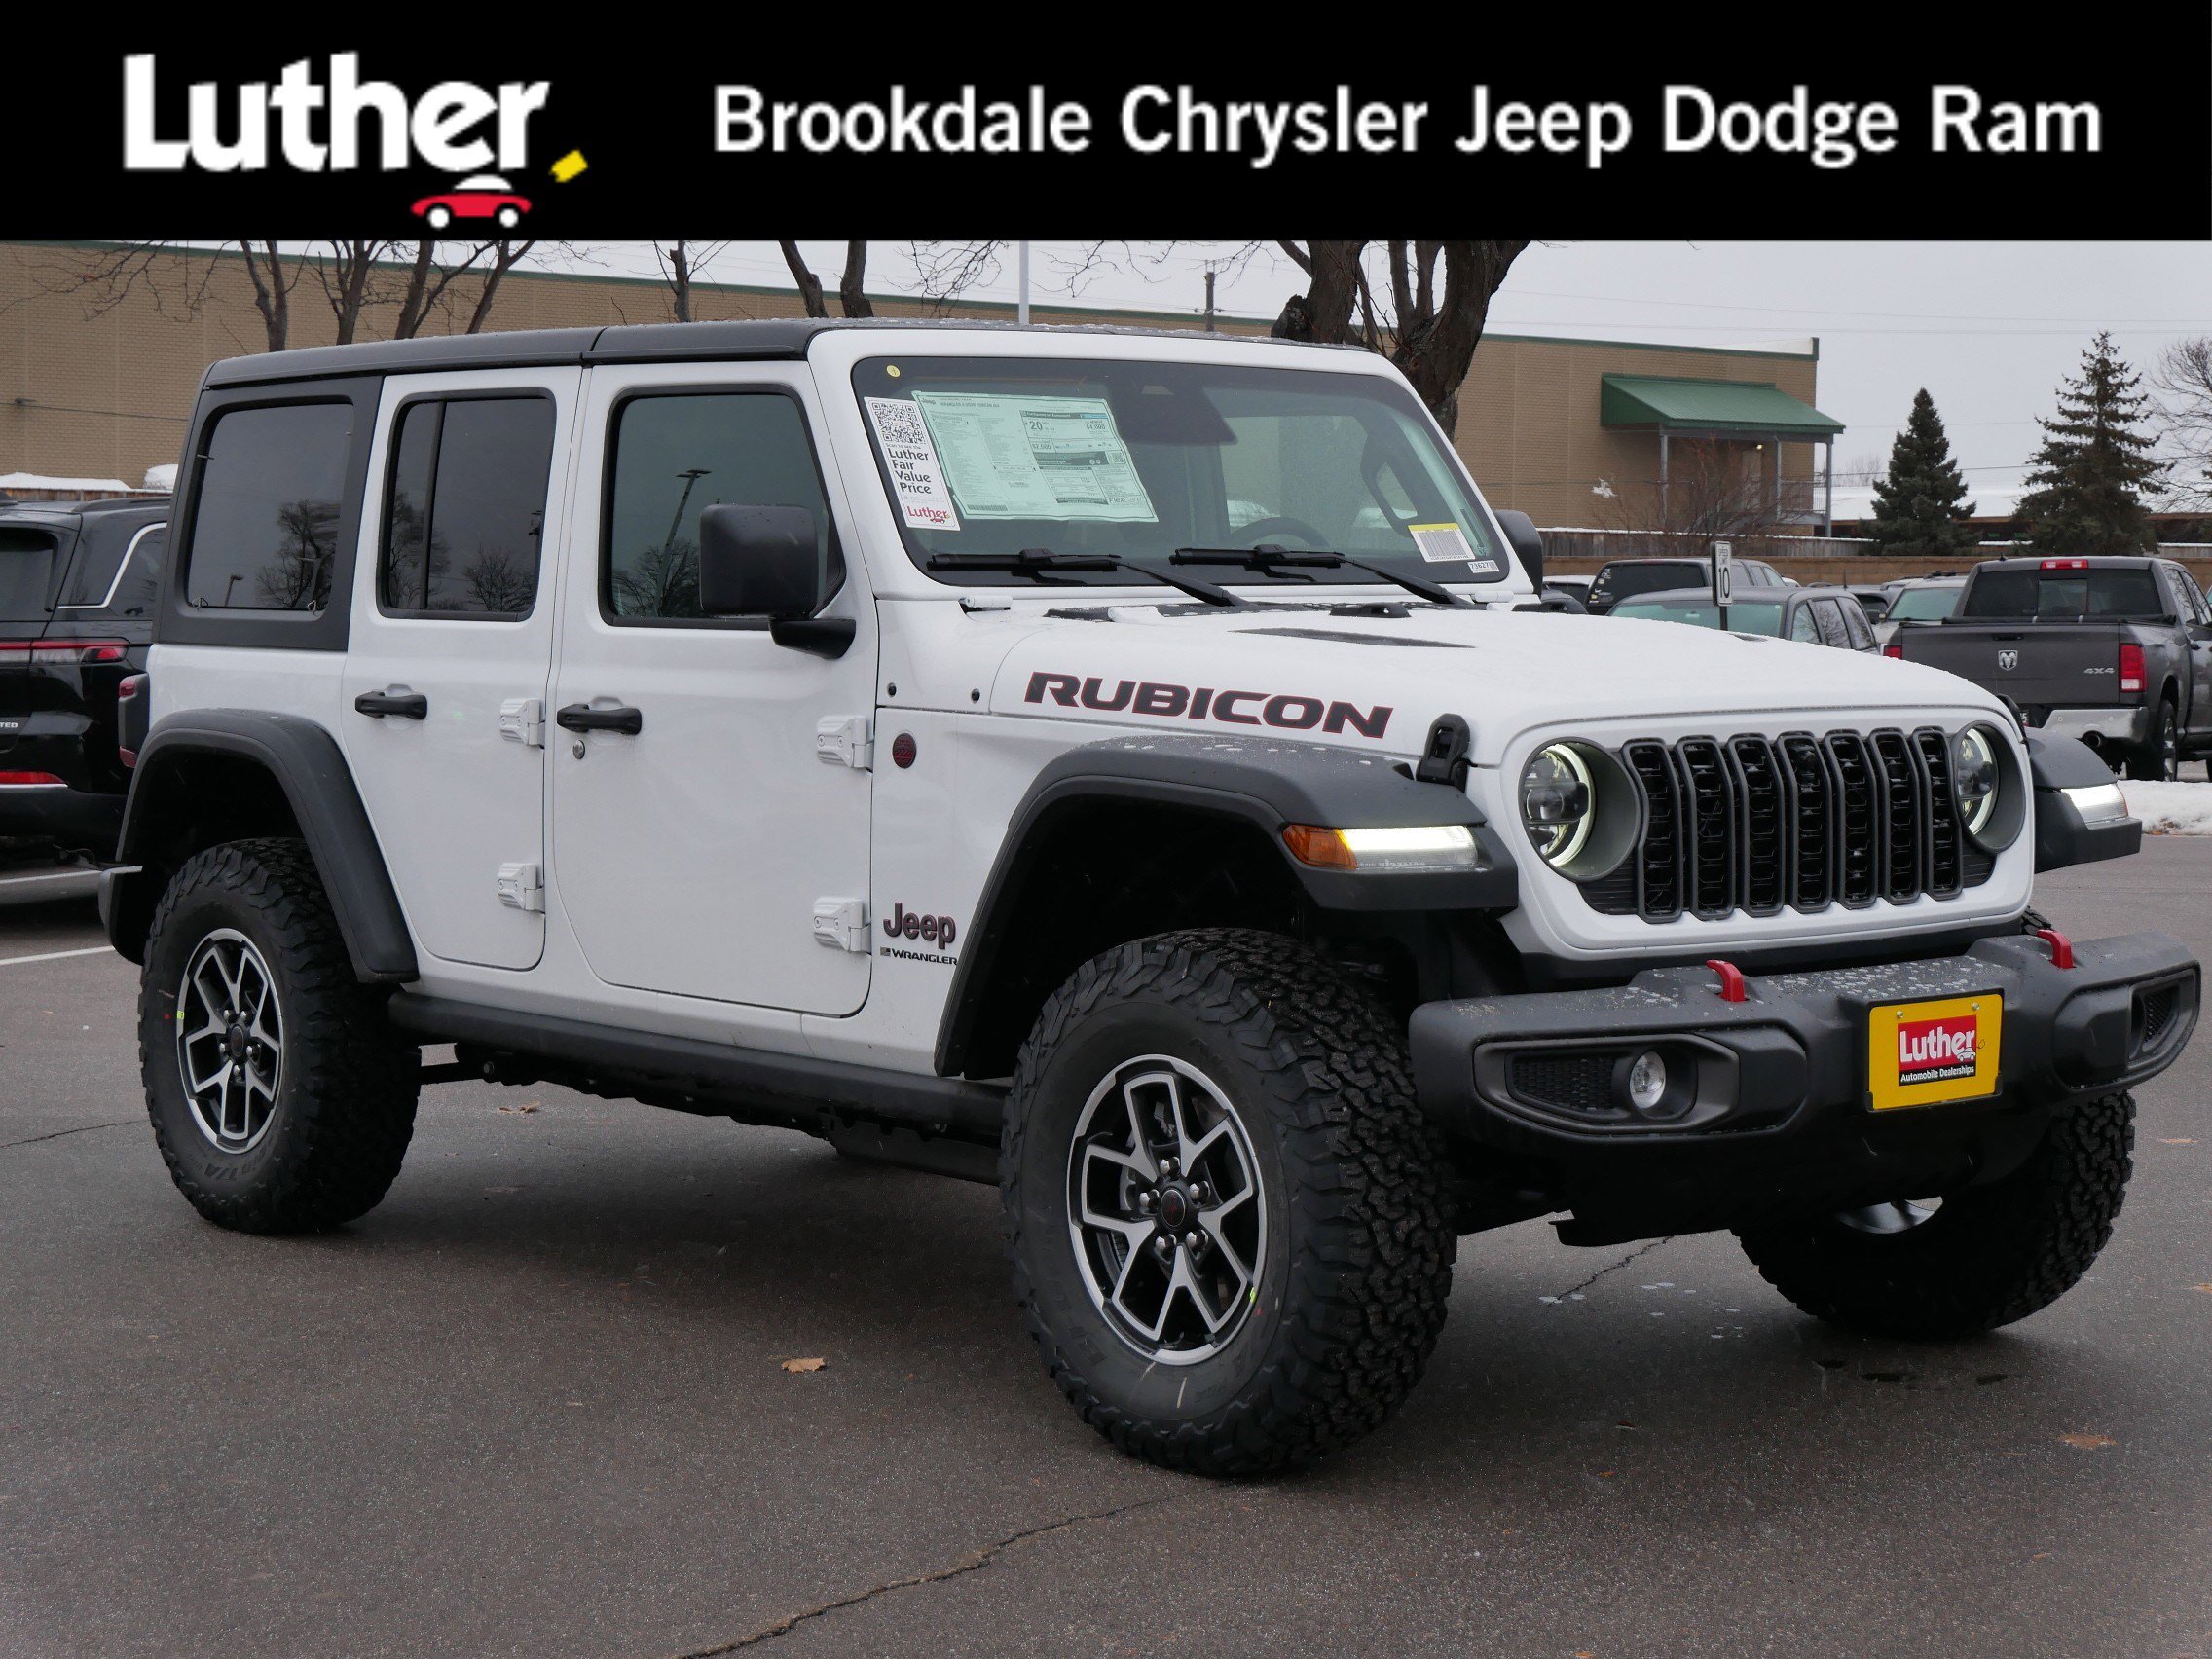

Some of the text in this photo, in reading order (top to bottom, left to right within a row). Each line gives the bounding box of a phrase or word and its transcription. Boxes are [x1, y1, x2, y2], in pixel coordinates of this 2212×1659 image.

[888, 448, 929, 461] Luther
[891, 459, 914, 470] Fair
[895, 470, 932, 483] Value
[899, 482, 932, 494] Price
[906, 506, 947, 519] Luther
[1718, 567, 1730, 598] 10
[1023, 671, 1394, 740] RUBICON
[883, 902, 956, 950] Jeep
[891, 947, 958, 966] WRANGLER
[1899, 1025, 1975, 1063] Luther
[1900, 1064, 1974, 1083] Automobile Dealerships
